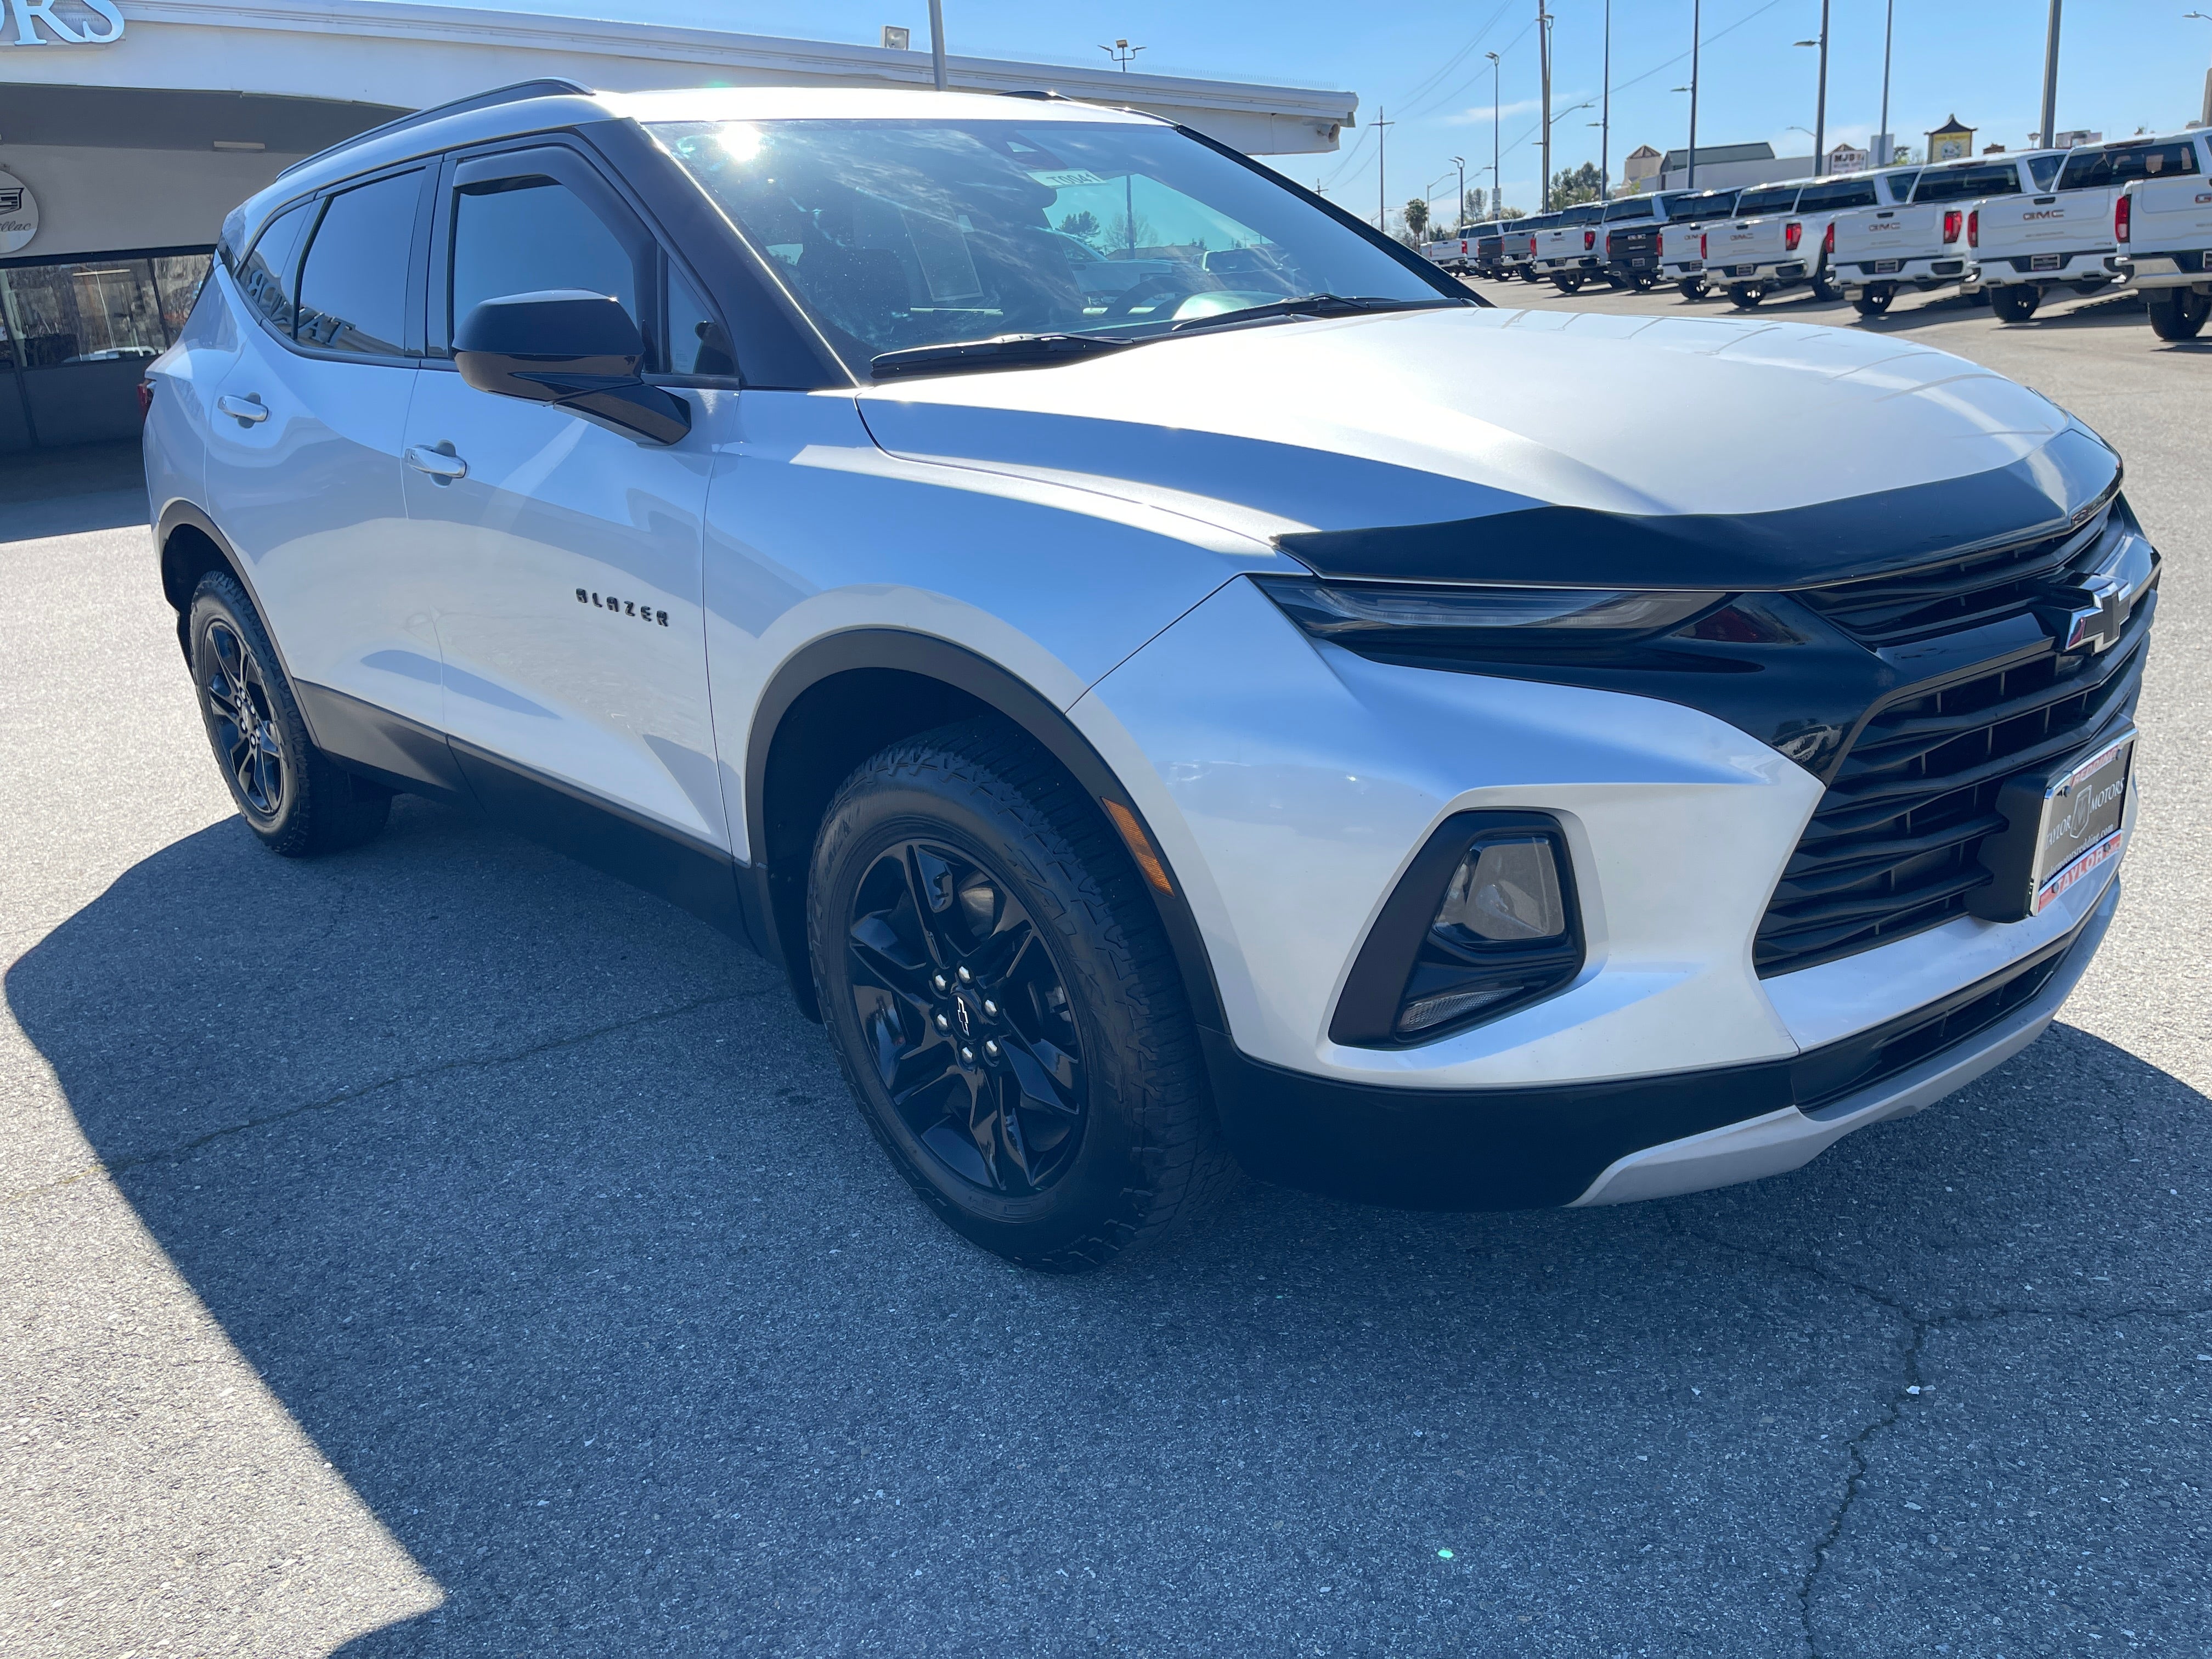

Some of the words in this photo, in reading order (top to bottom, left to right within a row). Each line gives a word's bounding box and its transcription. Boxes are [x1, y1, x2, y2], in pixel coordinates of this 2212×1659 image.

[0, 0, 125, 46] RS
[0, 221, 31, 232] llac
[1869, 222, 1900, 231] GMC
[2023, 209, 2064, 220] GMC
[575, 588, 669, 627] BLAZER
[2071, 745, 2119, 786] REDDING
[2045, 814, 2071, 851] TAYLOR
[2091, 777, 2125, 814] MOTORS
[2056, 846, 2103, 894] TAYLOR
